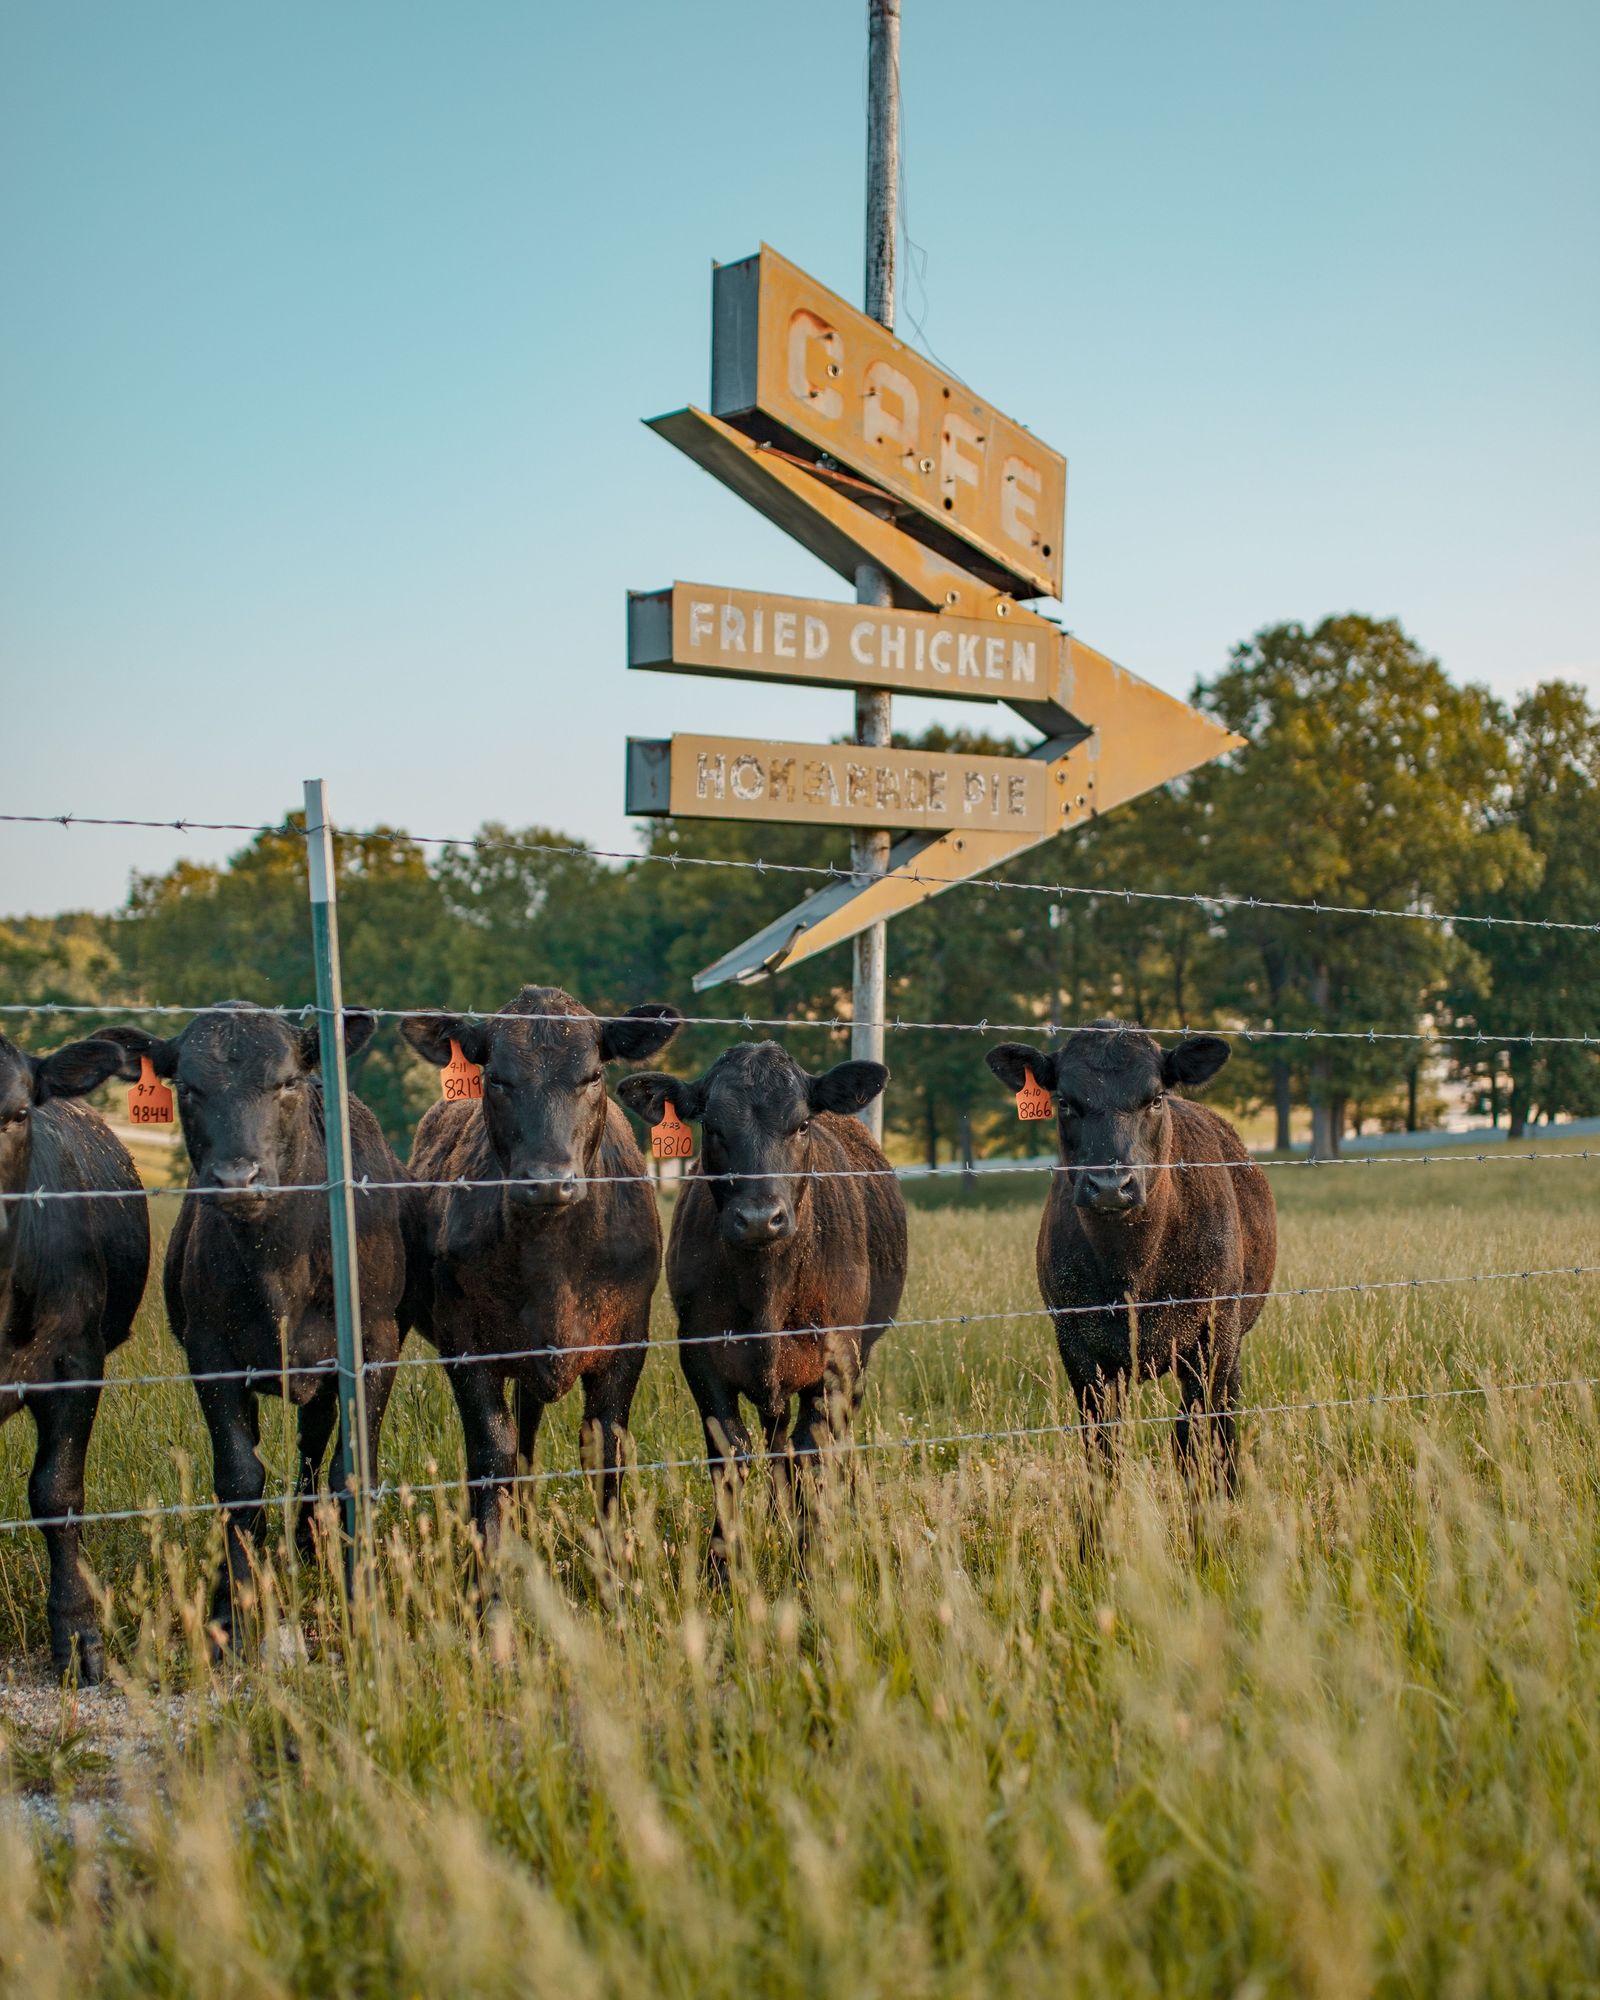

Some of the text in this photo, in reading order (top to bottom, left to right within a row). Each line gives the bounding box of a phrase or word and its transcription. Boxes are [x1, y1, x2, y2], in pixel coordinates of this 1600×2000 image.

[787, 307, 1043, 548] CAFE
[689, 601, 1036, 683] FRIED CHICKEN
[962, 770, 1026, 817] PIE
[450, 1062, 467, 1073] 9-11
[137, 1083, 156, 1097] 9-7
[444, 1075, 482, 1099] 8219
[1023, 1088, 1041, 1097] 9-10
[132, 1104, 169, 1123] 9844
[1019, 1100, 1052, 1119] 8266
[652, 1136, 692, 1158] 9810
